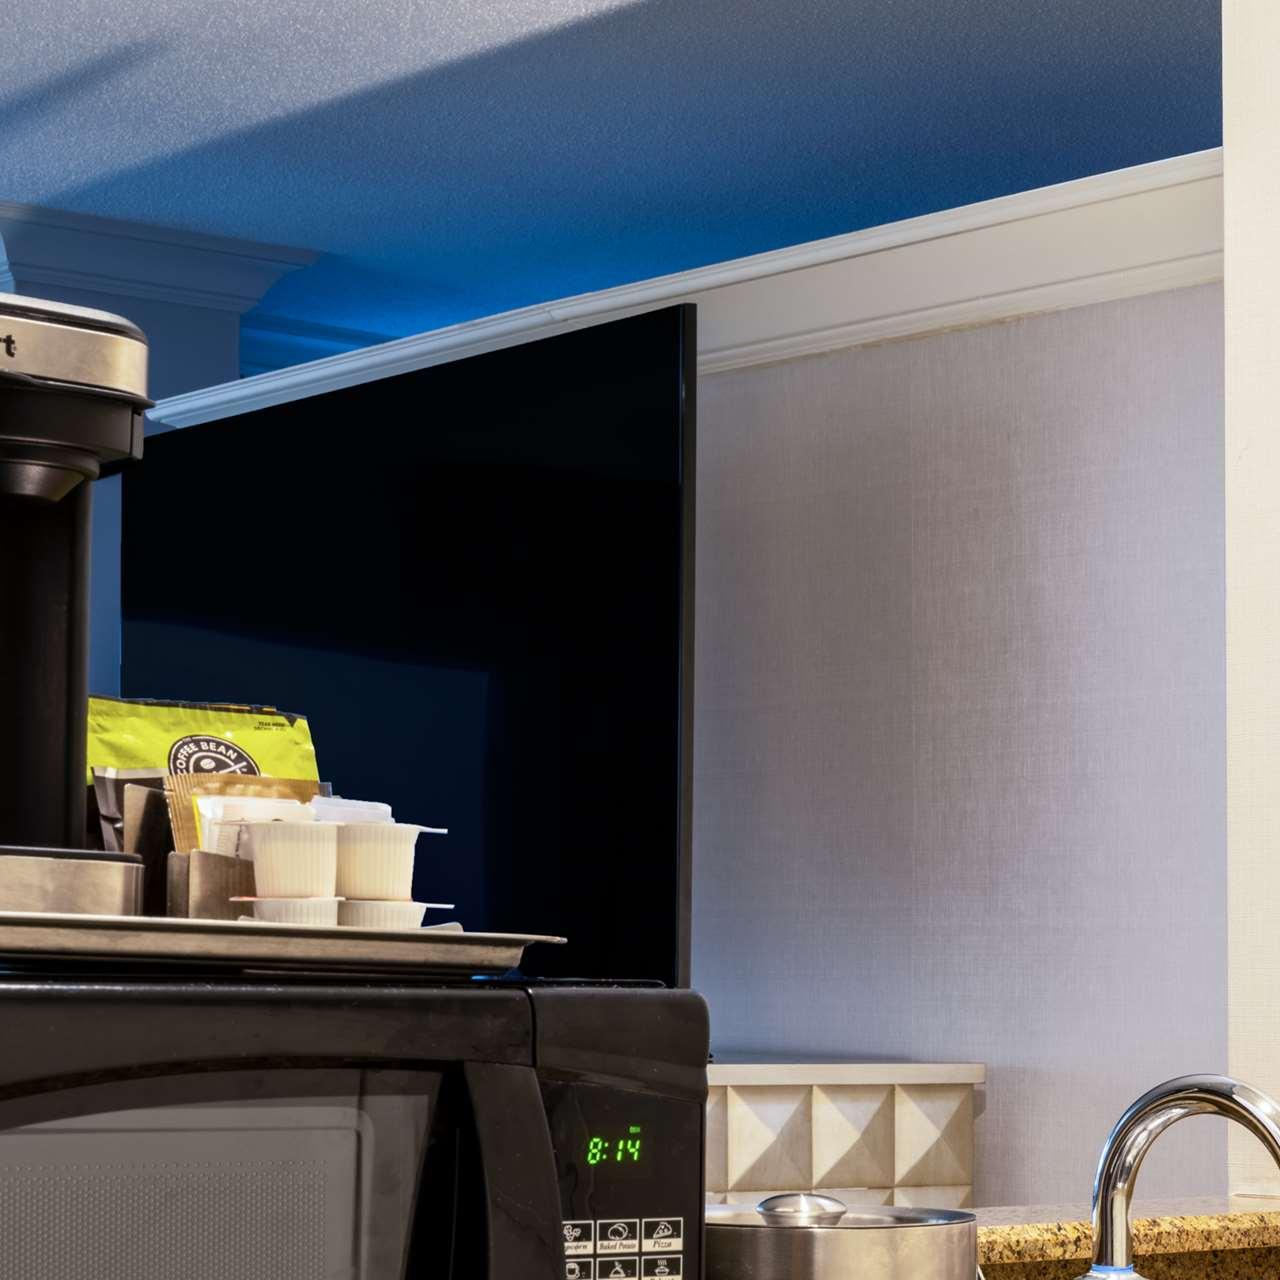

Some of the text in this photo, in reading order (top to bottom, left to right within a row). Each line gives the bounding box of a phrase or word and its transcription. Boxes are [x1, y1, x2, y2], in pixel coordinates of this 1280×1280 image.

[200, 742, 238, 760] BEAN
[587, 1137, 640, 1165] 8:14
[653, 1240, 672, 1248] Pizza
